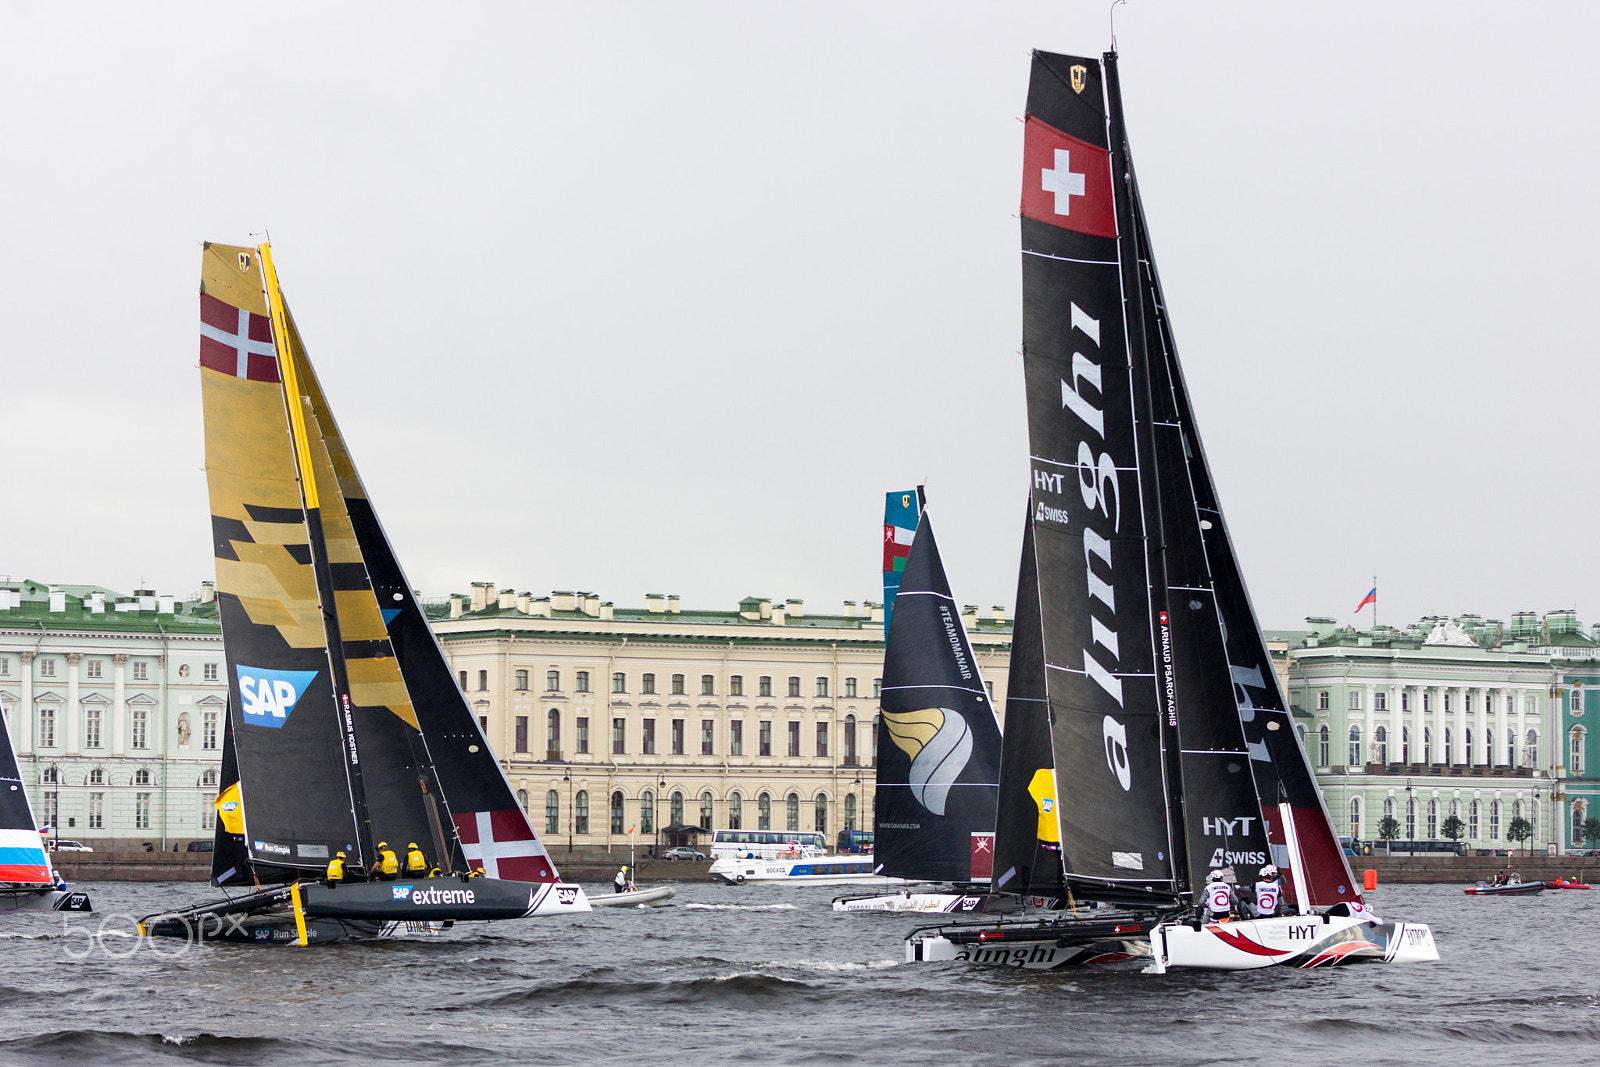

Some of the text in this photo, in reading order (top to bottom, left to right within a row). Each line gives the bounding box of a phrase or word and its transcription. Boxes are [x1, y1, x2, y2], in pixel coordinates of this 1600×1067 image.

[1034, 469, 1064, 495] HYT
[1044, 506, 1069, 524] SWISS
[1061, 301, 1131, 792] alinghi
[939, 605, 972, 680] #TEAMOMANAIR
[1160, 625, 1177, 727] ARNAUD PSAROFAGHIS
[239, 675, 296, 718] SAP
[343, 704, 354, 732] RASMUS
[1202, 817, 1257, 836] HYT
[264, 844, 275, 853] Run
[274, 845, 291, 855] Simple
[1225, 852, 1266, 865] SWISS
[71, 897, 83, 906] SAP
[393, 887, 475, 905] SAP extreme
[558, 889, 576, 902] SAP
[963, 900, 976, 908] SAP
[255, 931, 270, 939] SAP
[274, 930, 289, 939] Run
[1289, 925, 1317, 940] HYT
